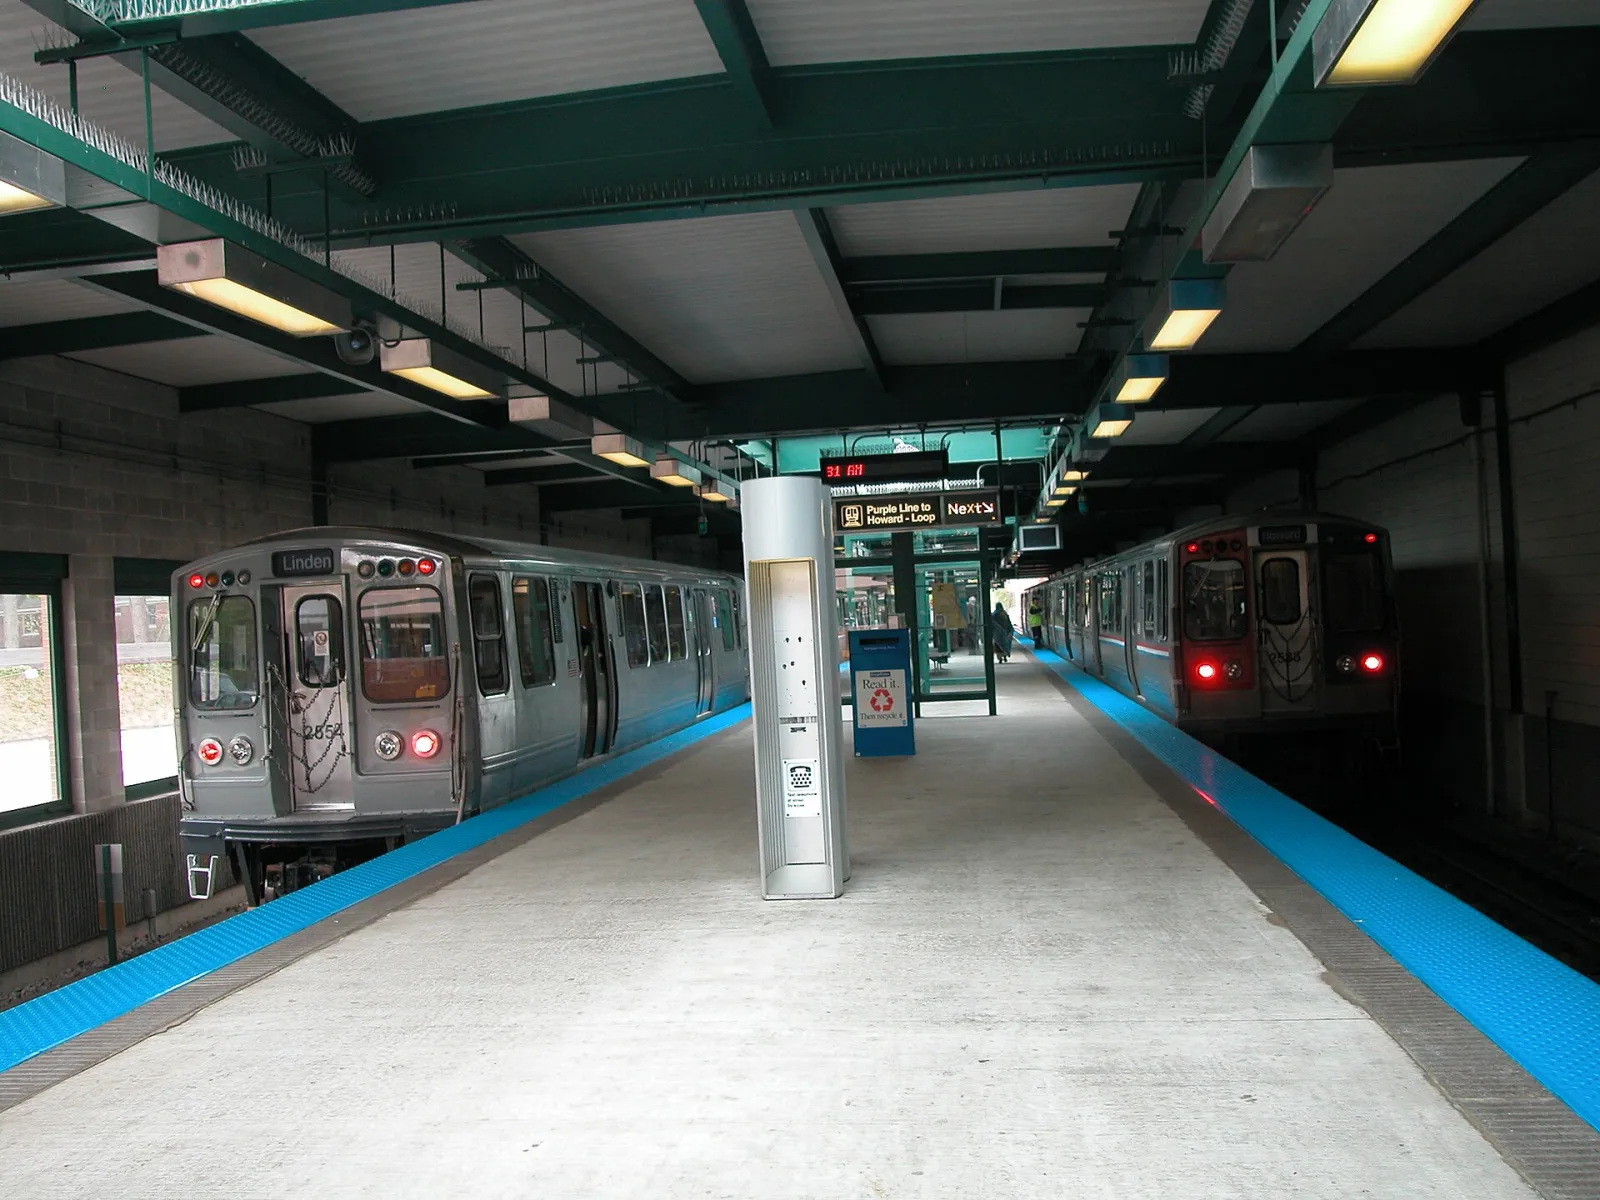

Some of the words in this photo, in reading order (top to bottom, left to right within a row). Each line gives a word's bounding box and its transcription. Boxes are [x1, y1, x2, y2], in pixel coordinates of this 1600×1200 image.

[826, 466, 840, 478] 31
[846, 464, 864, 476] AM
[866, 504, 898, 516] Purple
[898, 503, 920, 514] Line
[921, 503, 932, 512] to
[947, 503, 982, 515] Next
[866, 514, 904, 525] Howard
[911, 512, 936, 524] Loop
[282, 553, 332, 571] Linden
[863, 678, 887, 690] Read
[890, 678, 900, 688] it.
[877, 712, 897, 721] recycle
